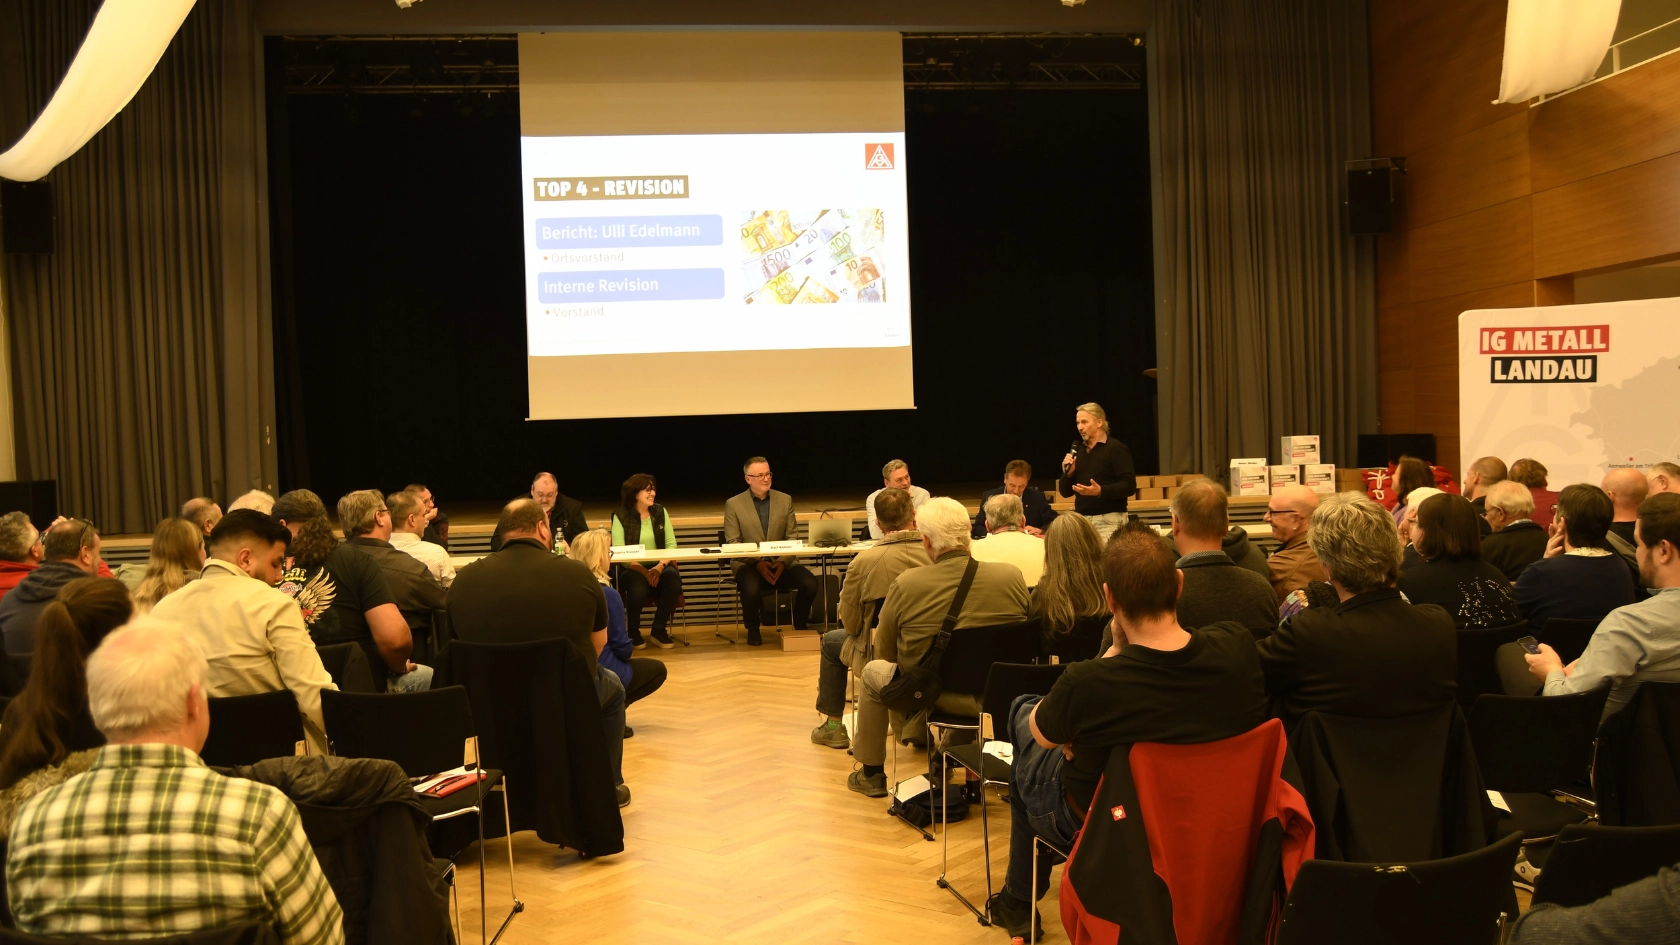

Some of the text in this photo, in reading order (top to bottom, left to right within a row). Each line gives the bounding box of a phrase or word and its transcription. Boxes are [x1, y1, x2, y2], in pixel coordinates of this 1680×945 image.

[537, 181, 571, 197] TOP
[576, 180, 587, 196] 4
[604, 179, 684, 196] REVISION
[542, 223, 700, 240] Bericht: Ulli Edelmann
[551, 252, 624, 264] Ortsvorstand
[544, 278, 659, 294] Interne Revision
[553, 306, 604, 318] Vorstand
[1482, 328, 1606, 352] IG METALL
[1494, 359, 1592, 380] LANDAU
